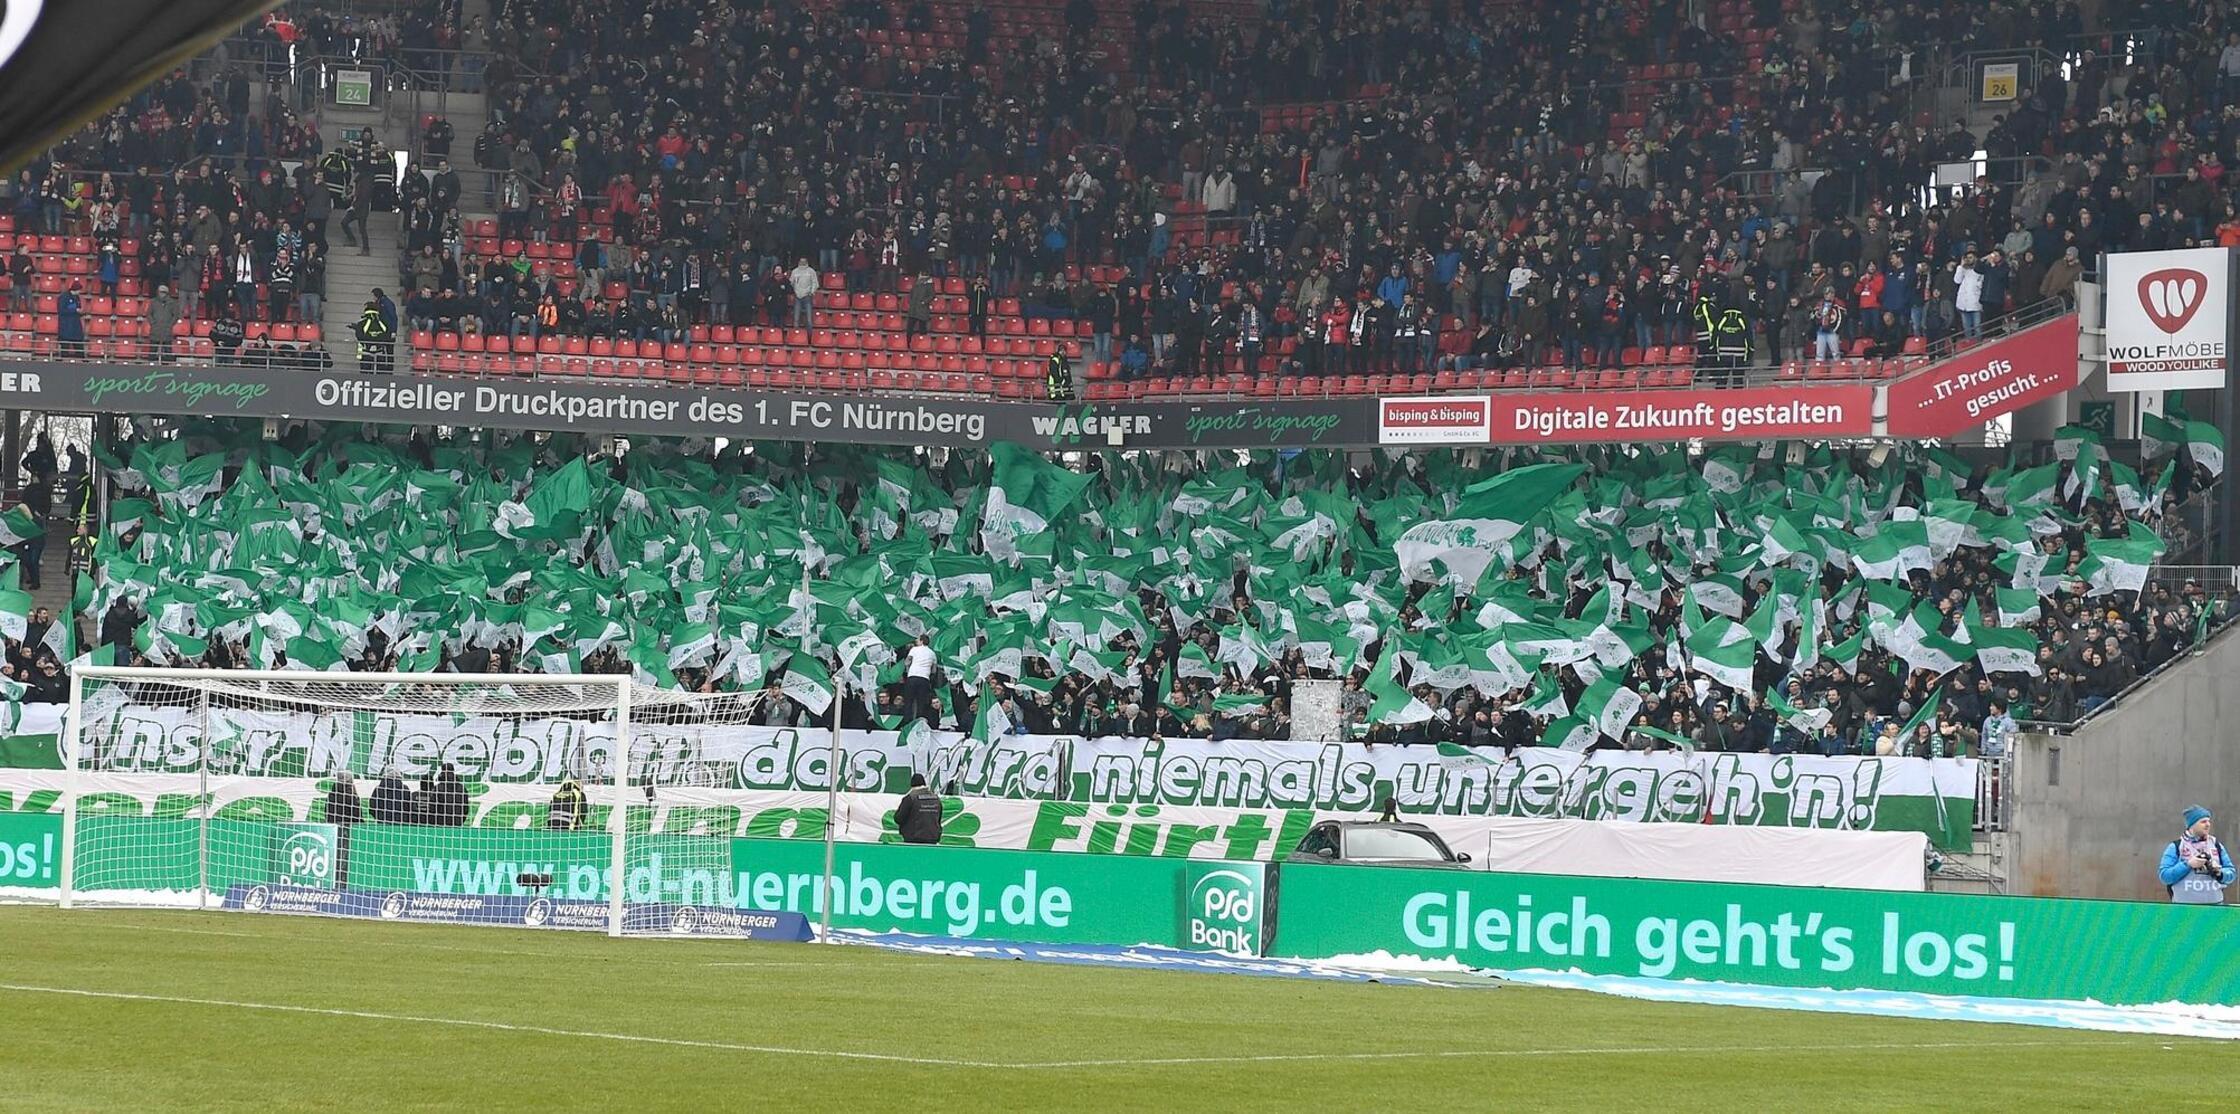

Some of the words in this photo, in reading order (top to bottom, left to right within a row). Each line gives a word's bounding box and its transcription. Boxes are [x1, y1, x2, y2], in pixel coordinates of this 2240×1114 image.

[345, 89, 361, 100] 24
[1991, 84, 2008, 96] 26
[1933, 359, 2012, 401] IT-Profis
[1966, 373, 2039, 417] gesucht
[83, 371, 174, 405] sport
[165, 373, 269, 409] signage
[315, 379, 465, 412] Offizieller
[475, 386, 679, 424] Druckpartner
[688, 396, 743, 423] des
[755, 399, 778, 425] 1.
[790, 400, 832, 428] FC
[843, 403, 986, 440] Nürnberg
[1185, 409, 1261, 442] sport
[1253, 408, 1341, 442] signage
[1389, 409, 1428, 424] bisping
[1429, 409, 1438, 420] &
[1440, 407, 1480, 423] bisping
[1515, 405, 1609, 436] Digitale
[1615, 403, 1715, 428] Zukunft
[1721, 401, 1842, 432] gestalten
[740, 728, 887, 792] das
[1091, 738, 1376, 809] niemals
[291, 846, 330, 877] psd
[2184, 880, 2220, 891] FOTO
[1204, 887, 1254, 922] psd
[1191, 918, 1253, 953] Bank
[1402, 890, 1611, 958] Gleich
[1882, 911, 2016, 981] los!
